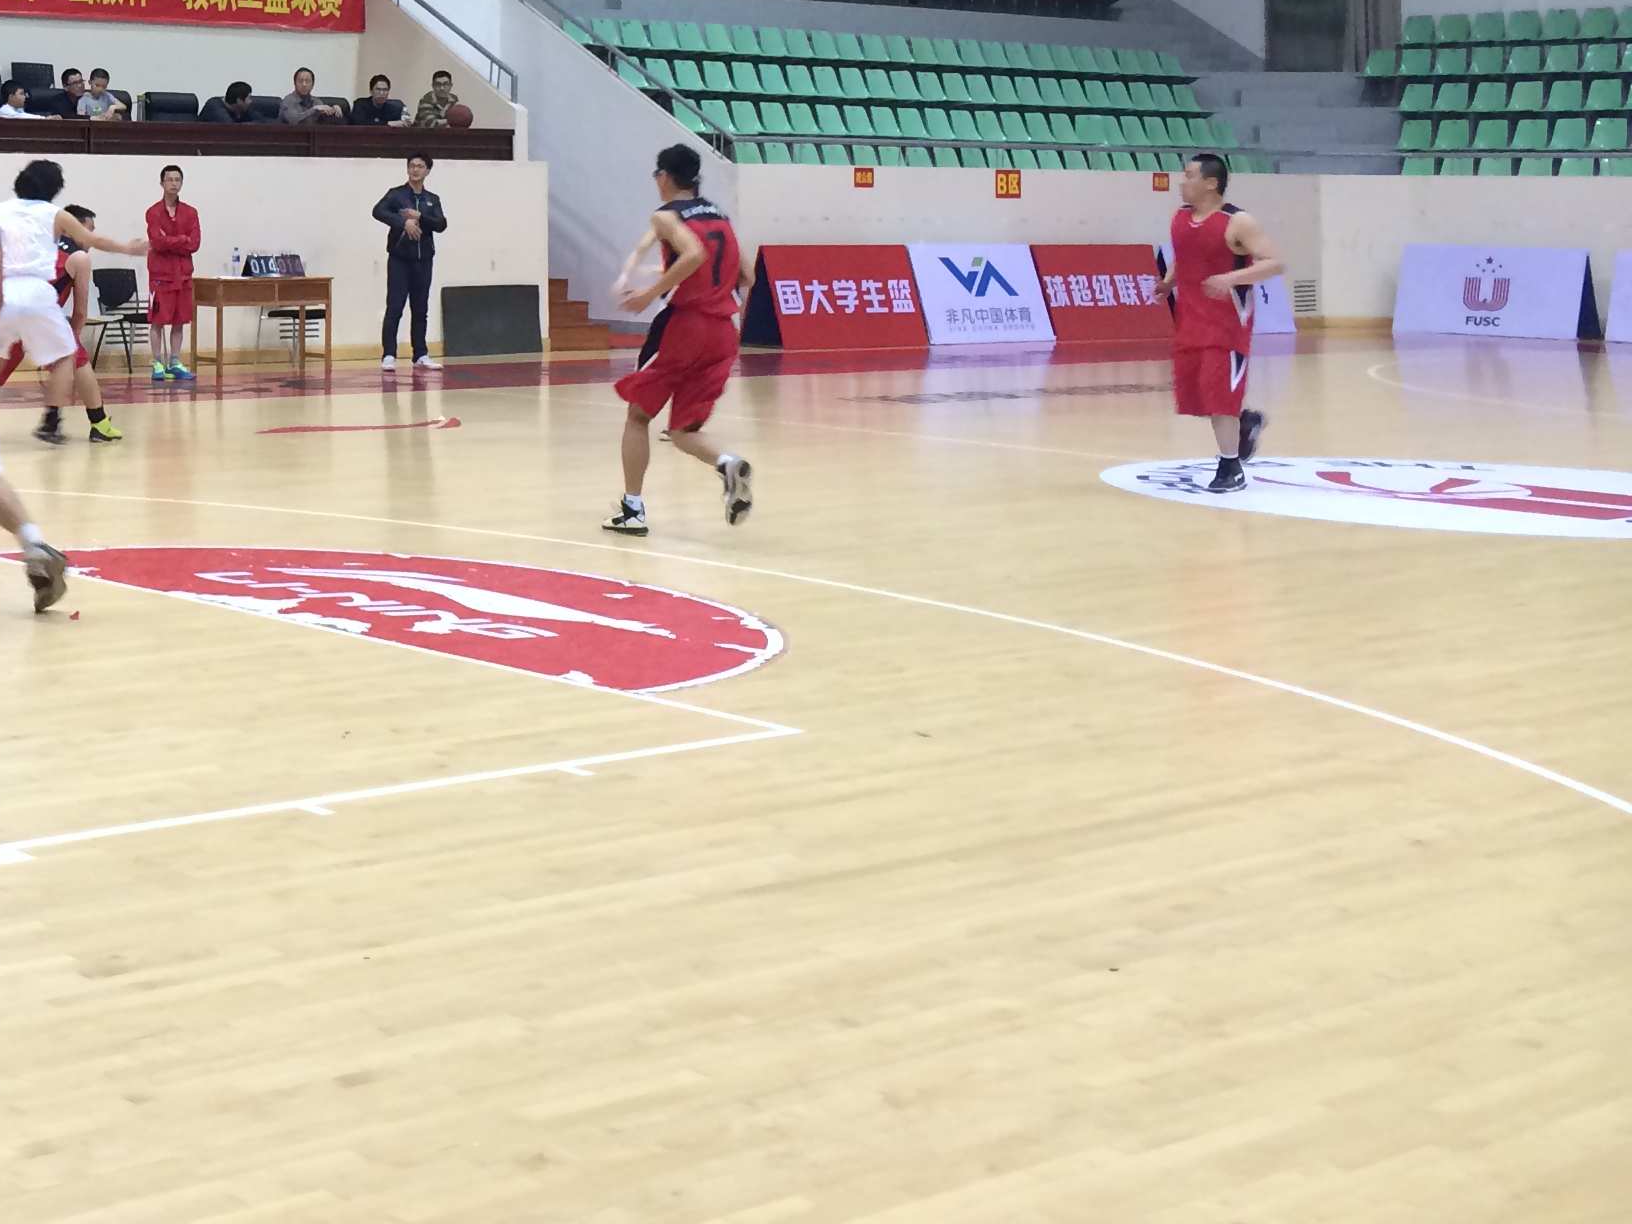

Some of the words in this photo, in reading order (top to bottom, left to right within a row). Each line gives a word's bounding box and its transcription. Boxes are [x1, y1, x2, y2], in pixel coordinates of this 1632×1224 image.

[997, 173, 1020, 195] B区
[706, 230, 726, 287] 7
[774, 279, 917, 316] 国大学生篮
[945, 307, 1032, 325] 非凡中国体育
[1465, 315, 1501, 328] FUSC
[194, 571, 560, 640] LI-NING
